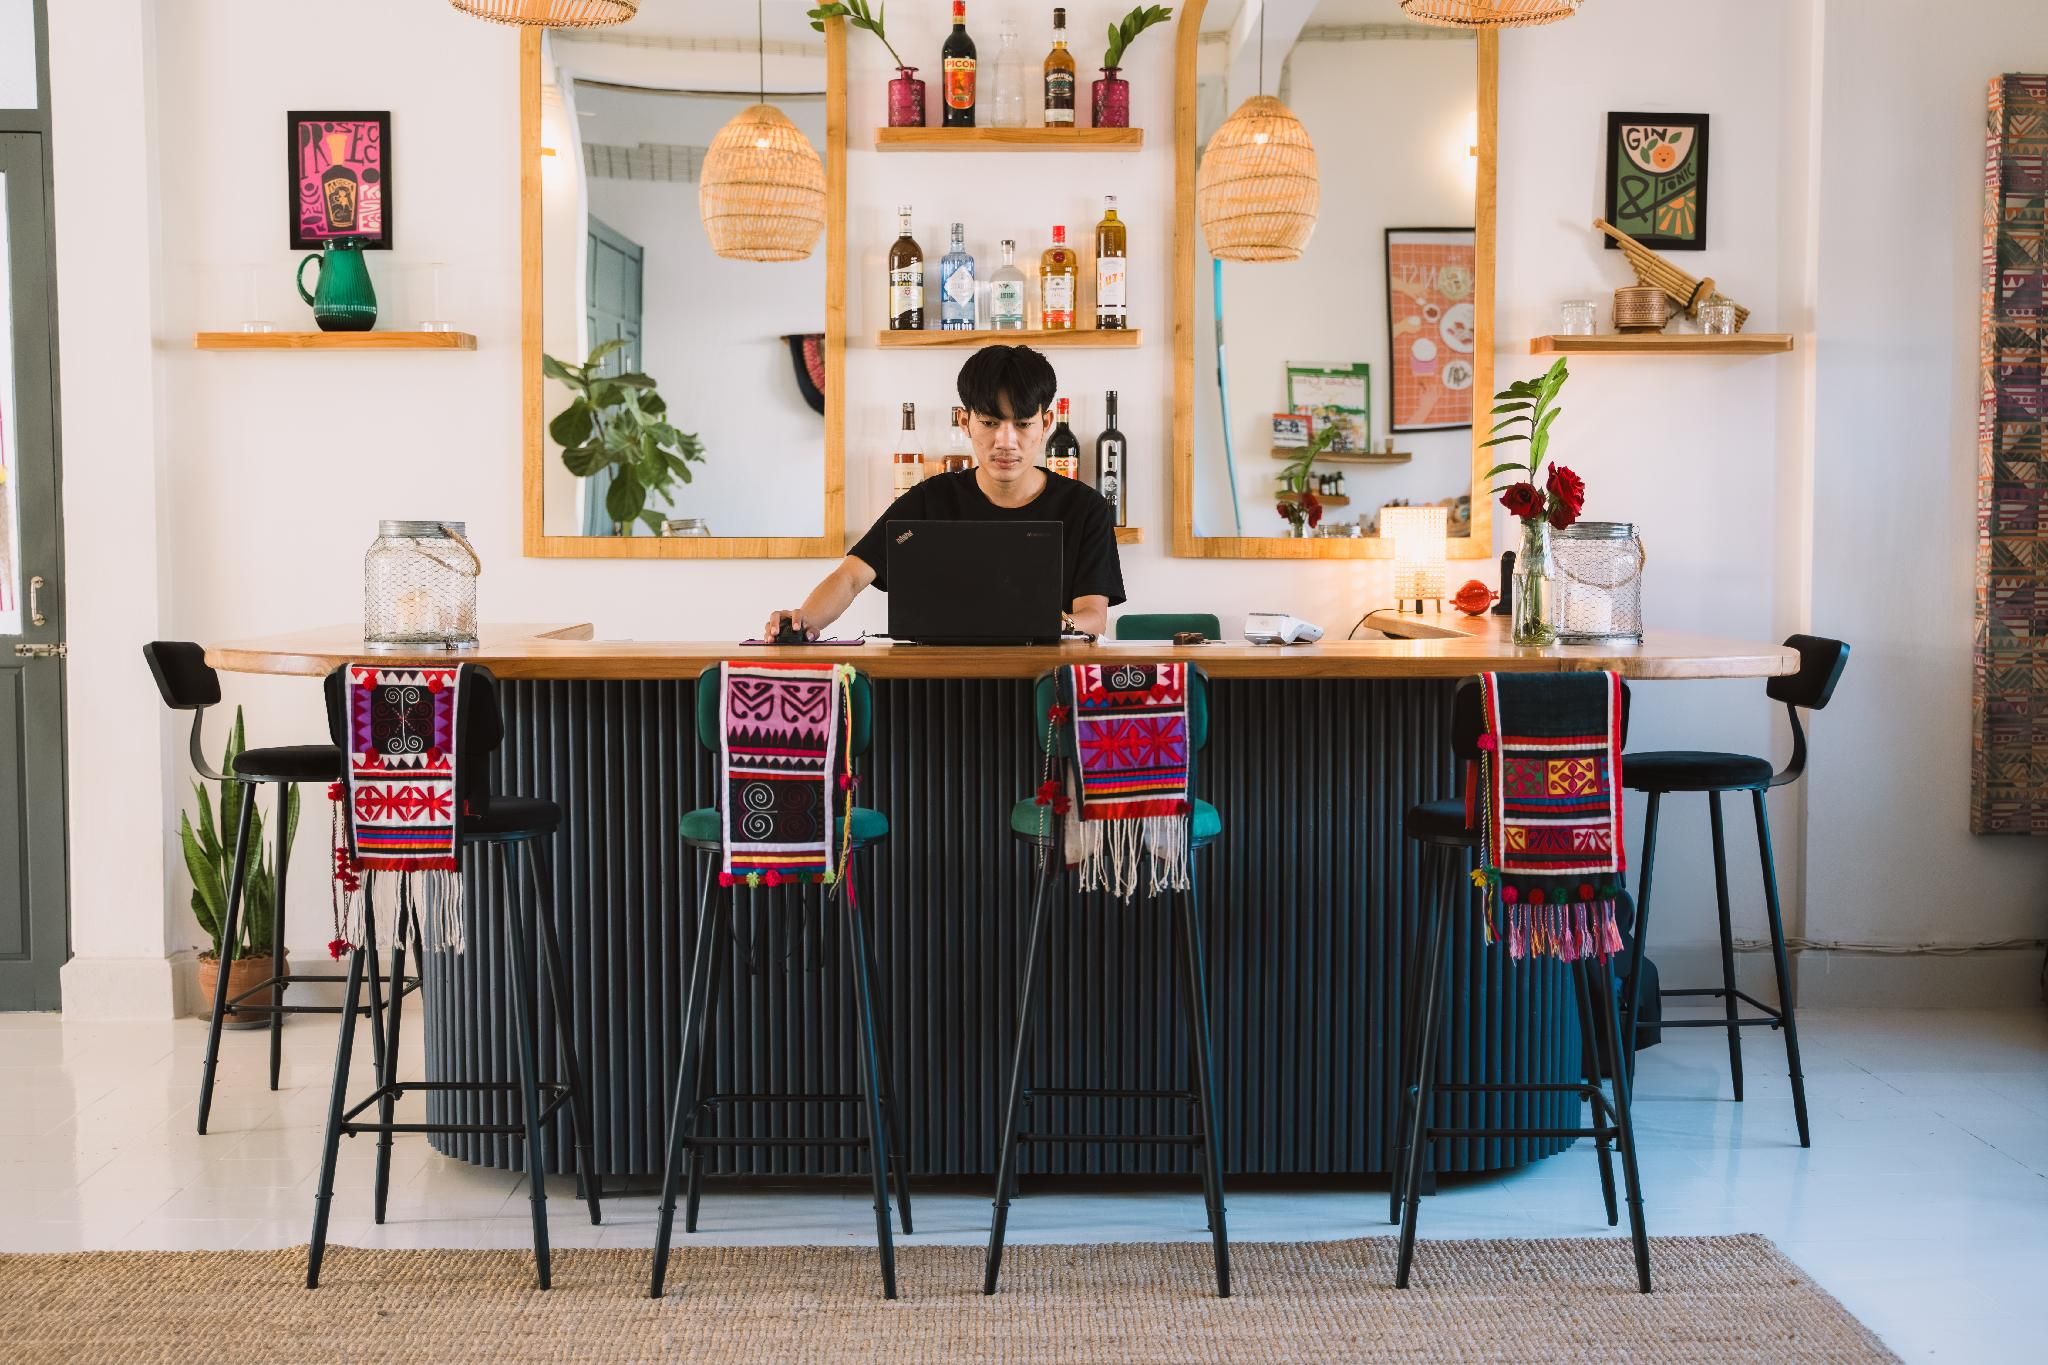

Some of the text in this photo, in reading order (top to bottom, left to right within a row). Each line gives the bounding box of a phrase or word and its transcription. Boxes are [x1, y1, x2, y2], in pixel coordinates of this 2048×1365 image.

[946, 60, 976, 70] PICON
[1626, 127, 1668, 151] GIN
[1659, 163, 1696, 195] TONIC
[891, 272, 922, 283] BERGER
